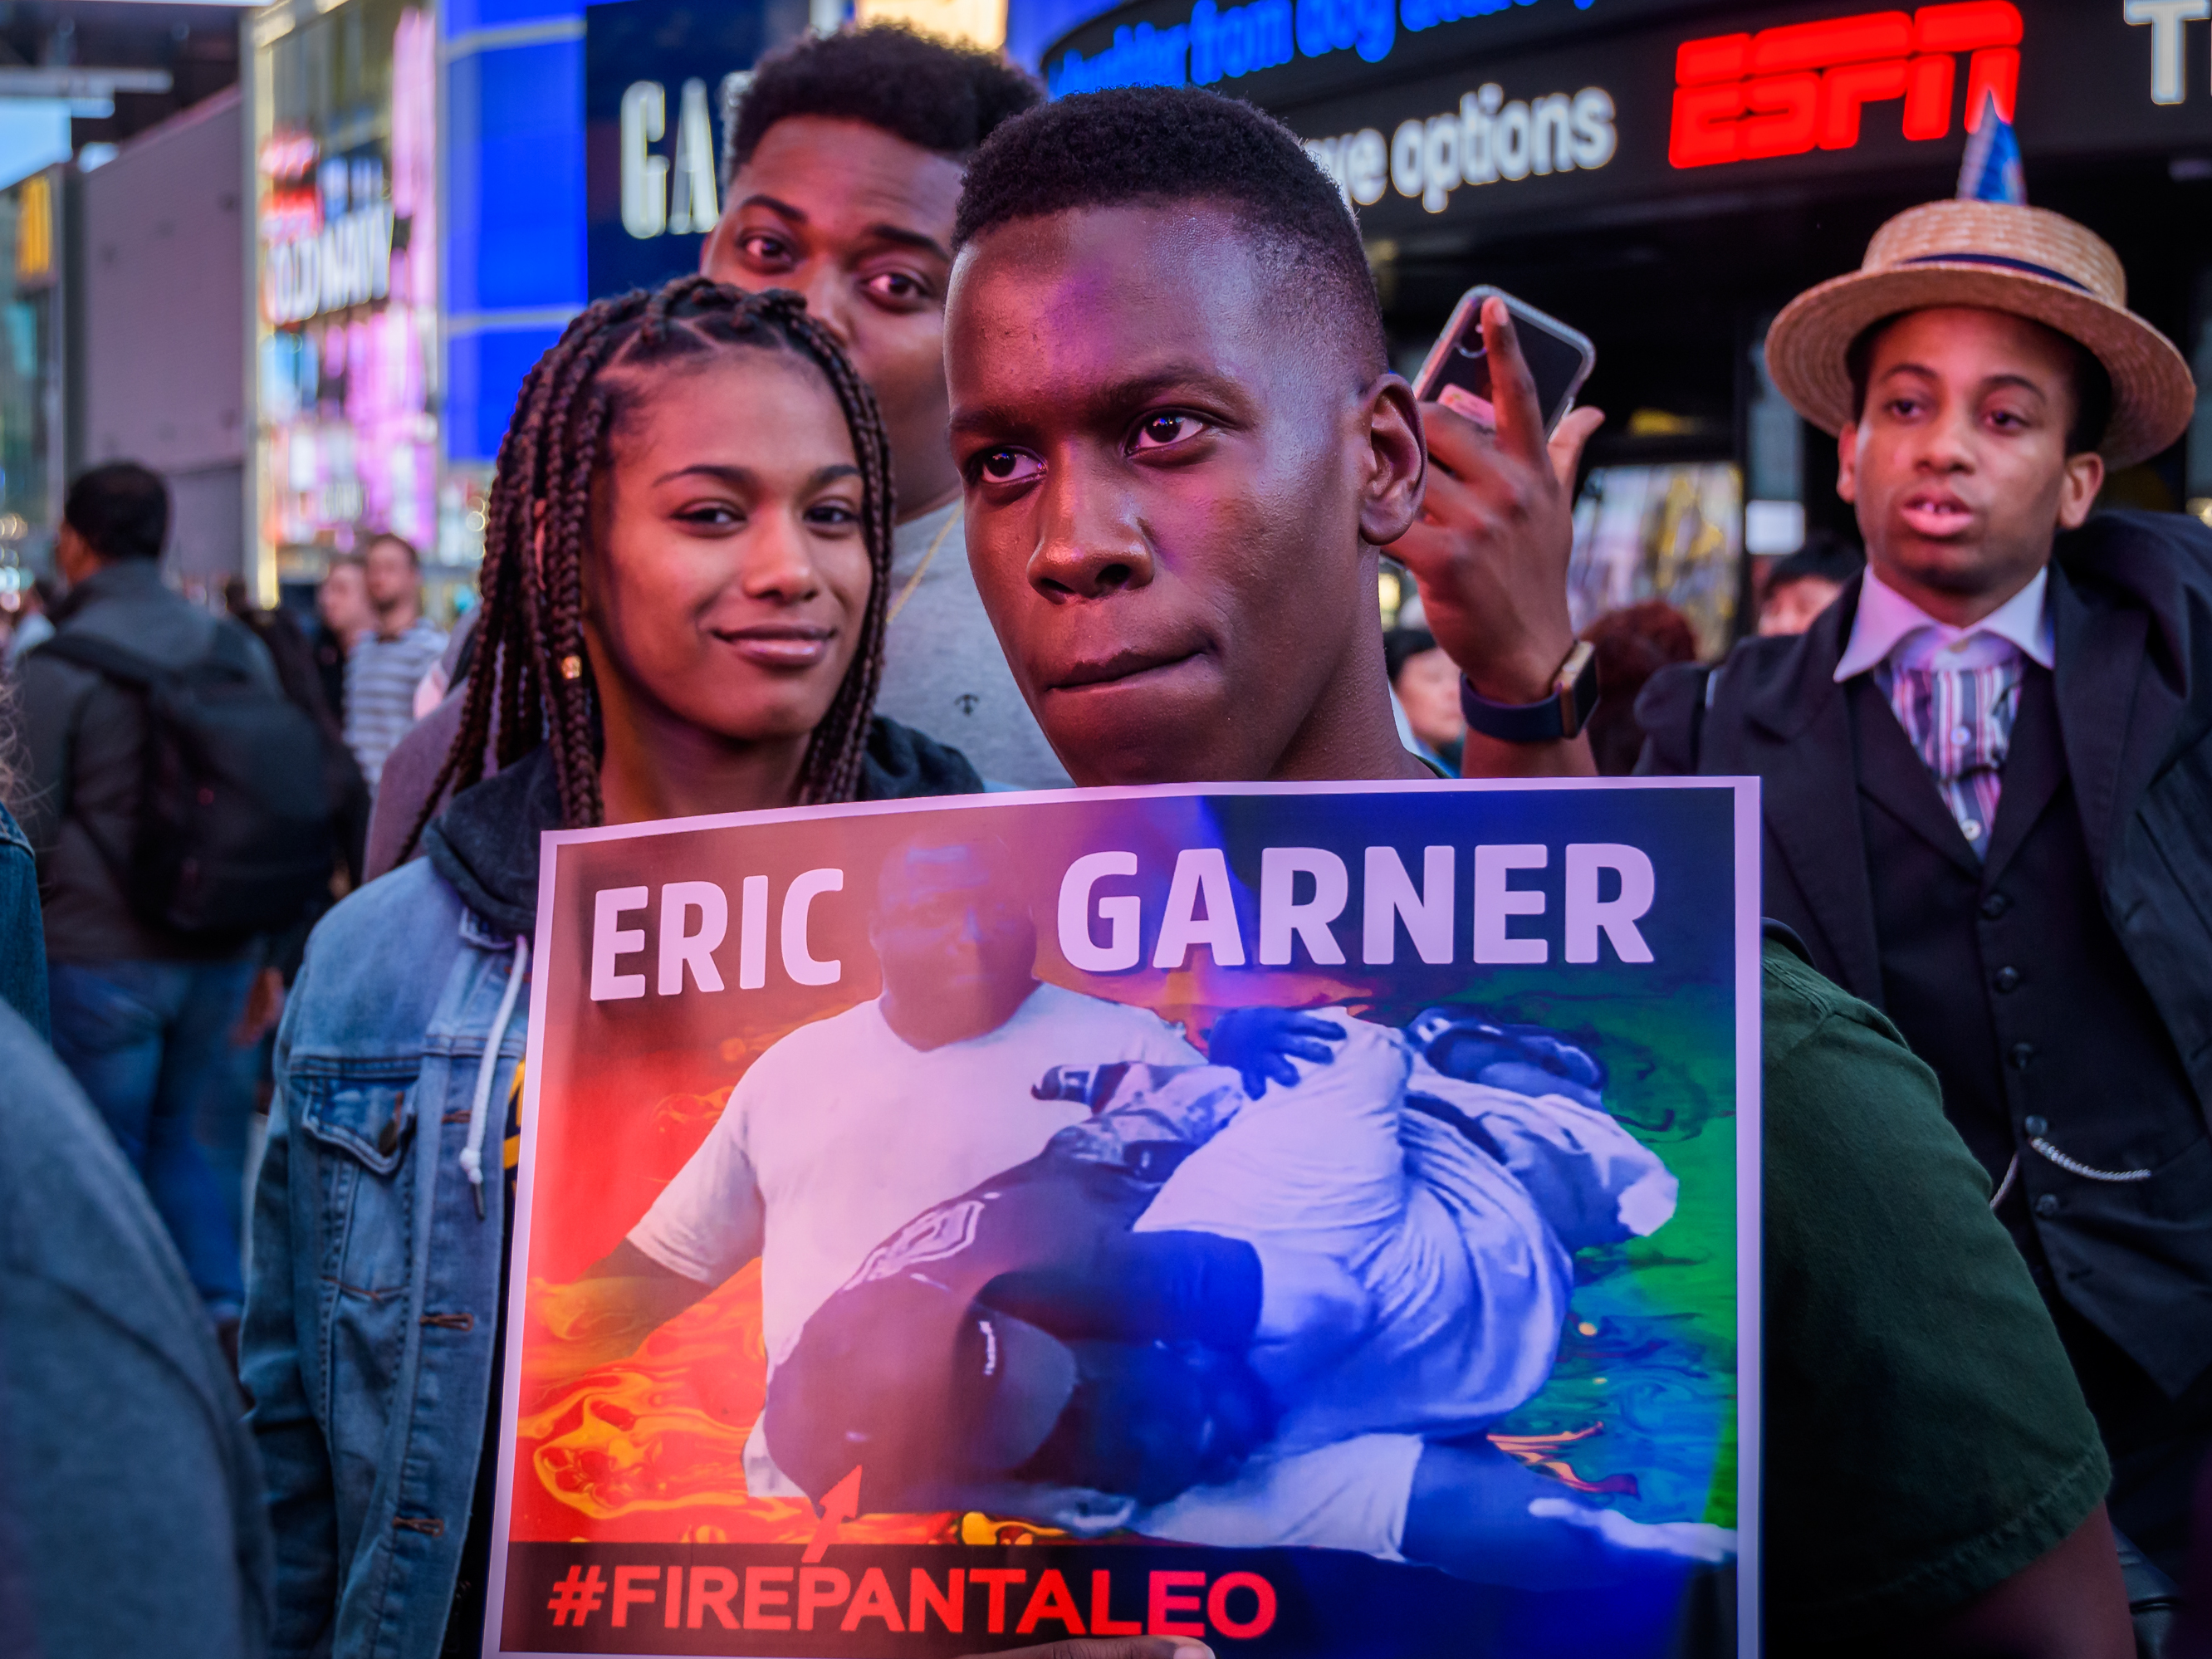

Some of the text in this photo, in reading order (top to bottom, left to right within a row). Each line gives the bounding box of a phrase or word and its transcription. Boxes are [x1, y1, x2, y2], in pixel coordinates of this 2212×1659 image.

[1390, 82, 1618, 213] options
[1669, 0, 2024, 169] ESPN
[590, 843, 1656, 1001] ERIC GARNER
[547, 1563, 1278, 1641] #FIREPANTALEO
